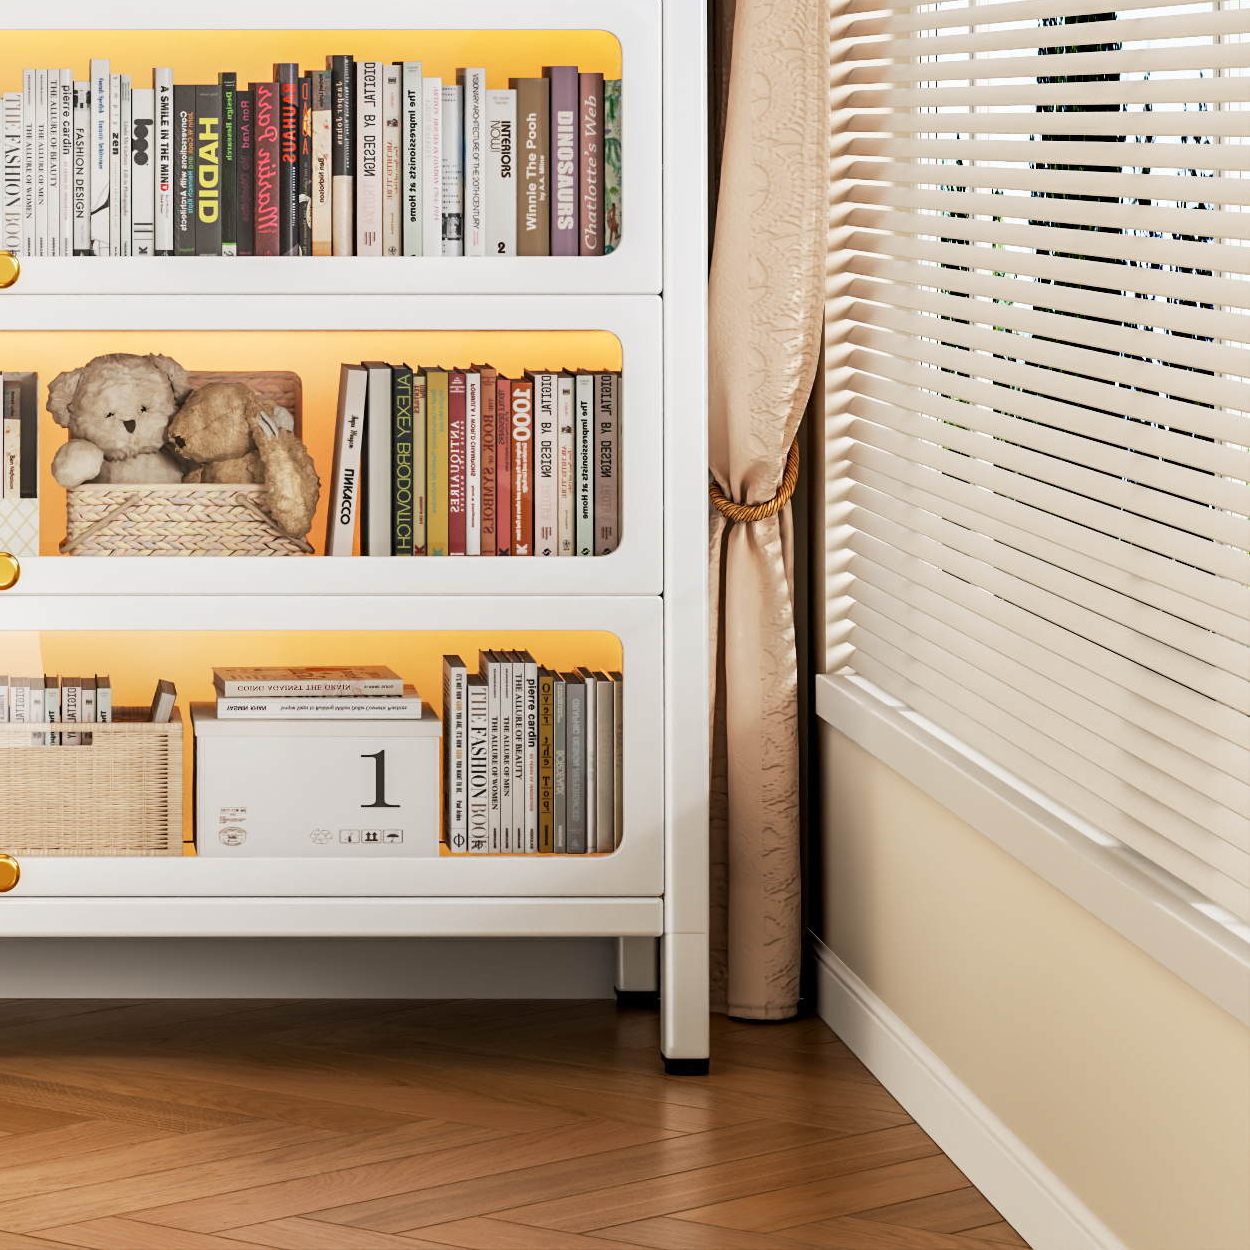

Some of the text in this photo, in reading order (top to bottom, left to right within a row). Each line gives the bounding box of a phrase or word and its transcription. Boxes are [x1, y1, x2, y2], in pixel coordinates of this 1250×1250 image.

[160, 85, 169, 192] A SMILE IN THE MIND
[585, 95, 597, 137] Web
[525, 112, 537, 231] Winnie The Pooh
[539, 191, 545, 201] by
[557, 111, 574, 230] DINOSAURS
[340, 468, 355, 525] ПИКАССО
[515, 673, 523, 780] THE ALLURE OF BEAUTY
[526, 678, 537, 748] pierre cardin
[360, 749, 401, 808] 1
[470, 687, 488, 850] THE FASHION BOOK
